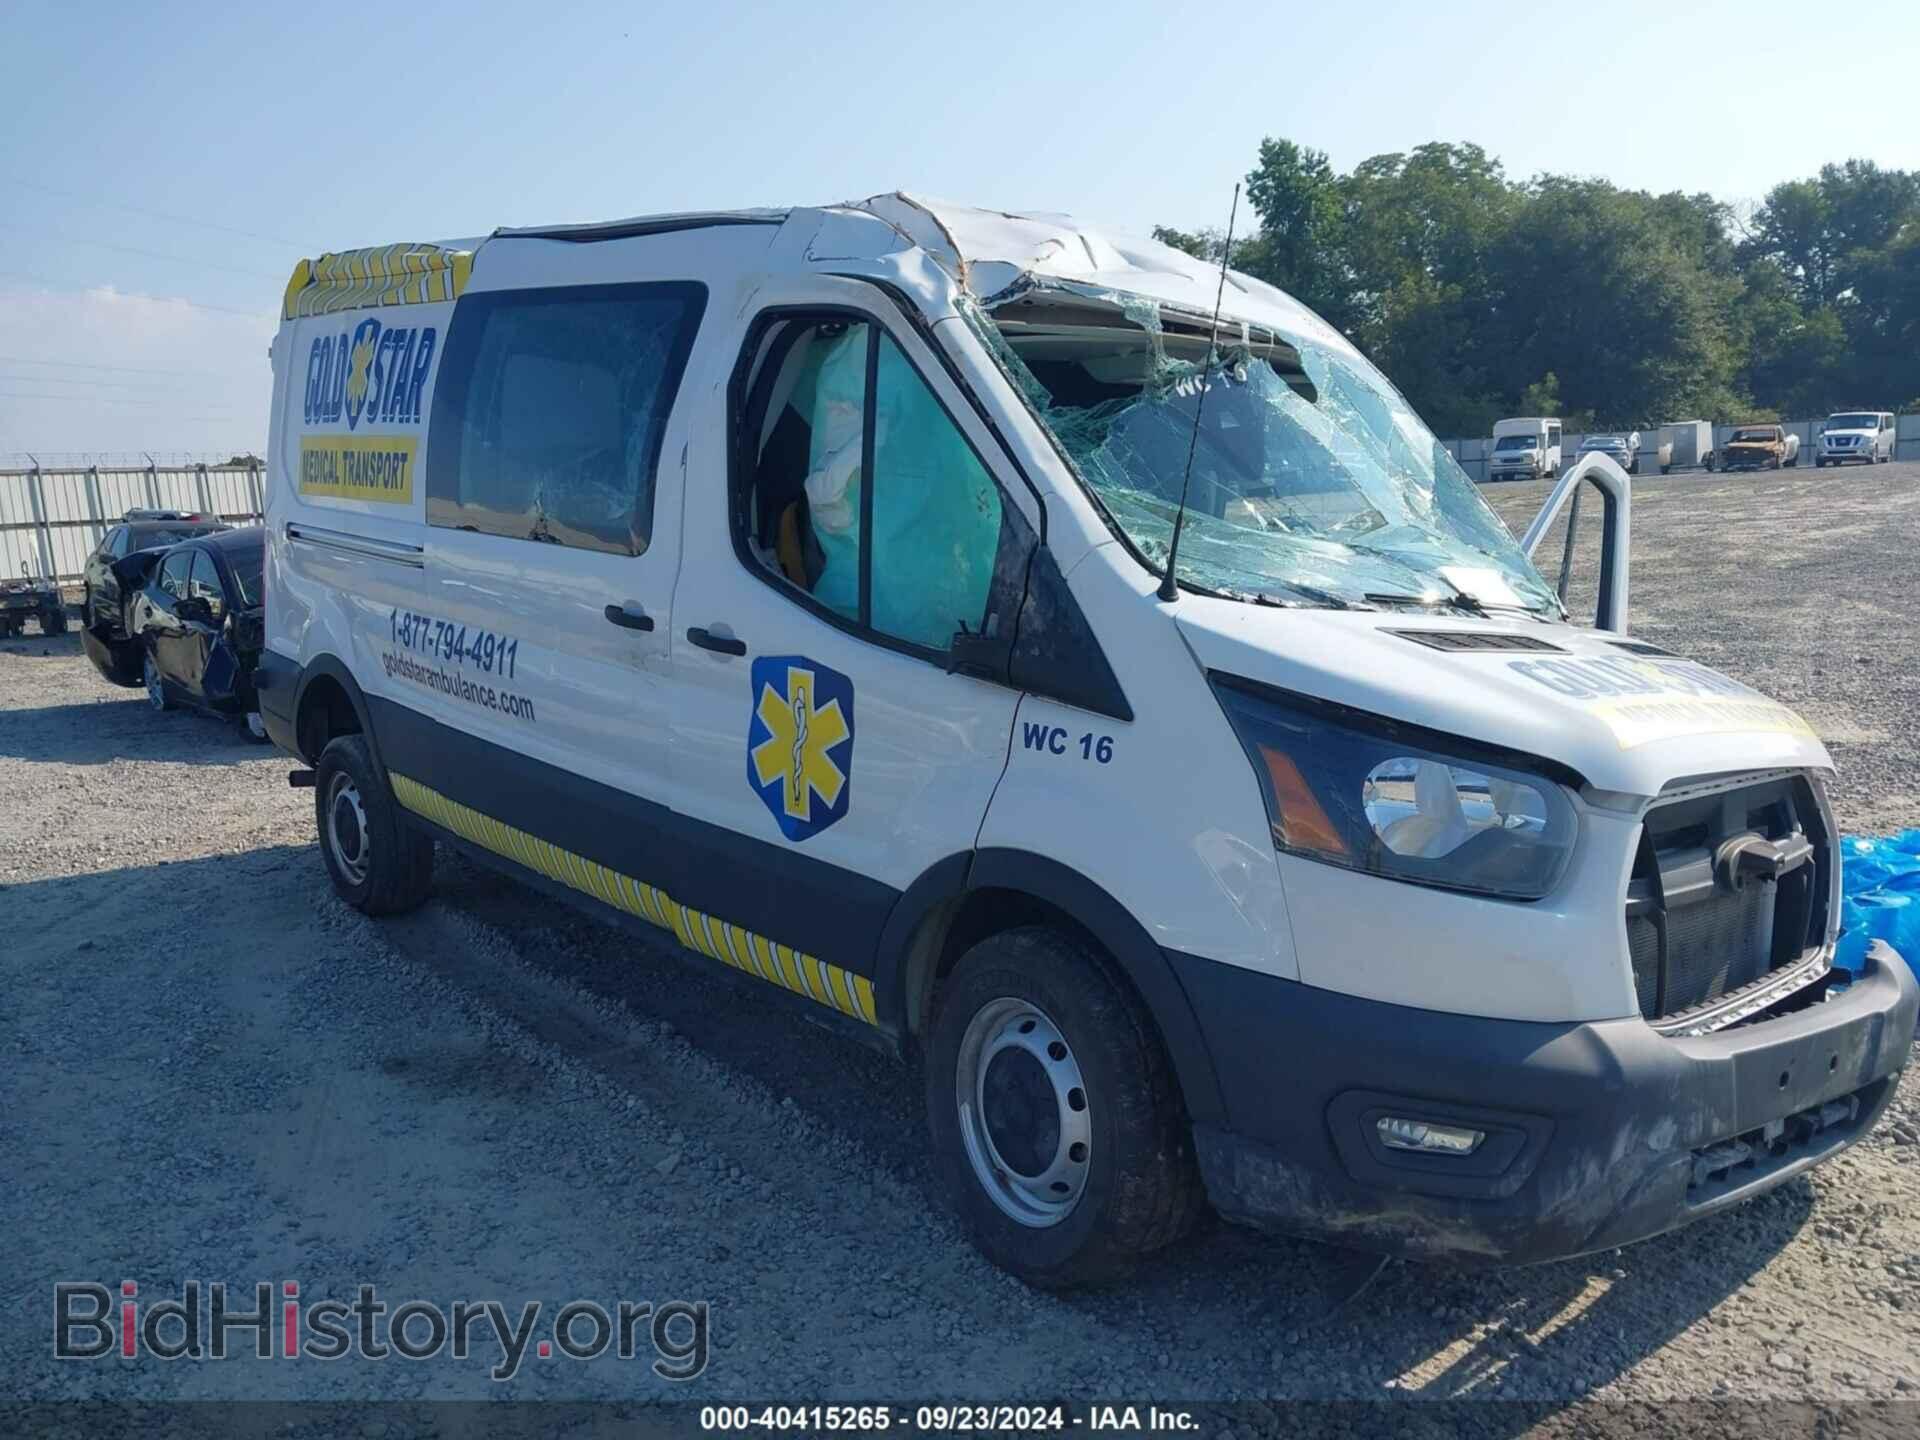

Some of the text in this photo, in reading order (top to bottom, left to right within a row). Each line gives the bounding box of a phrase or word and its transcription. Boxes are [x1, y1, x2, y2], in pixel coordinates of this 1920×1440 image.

[304, 327, 437, 425] GOLD STAR
[303, 450, 408, 490] MEDICAL TRANSPORT
[390, 607, 519, 679] 1-877-794-4911
[382, 651, 536, 721] goldstarambulance.com
[1023, 721, 1114, 764] WC 16
